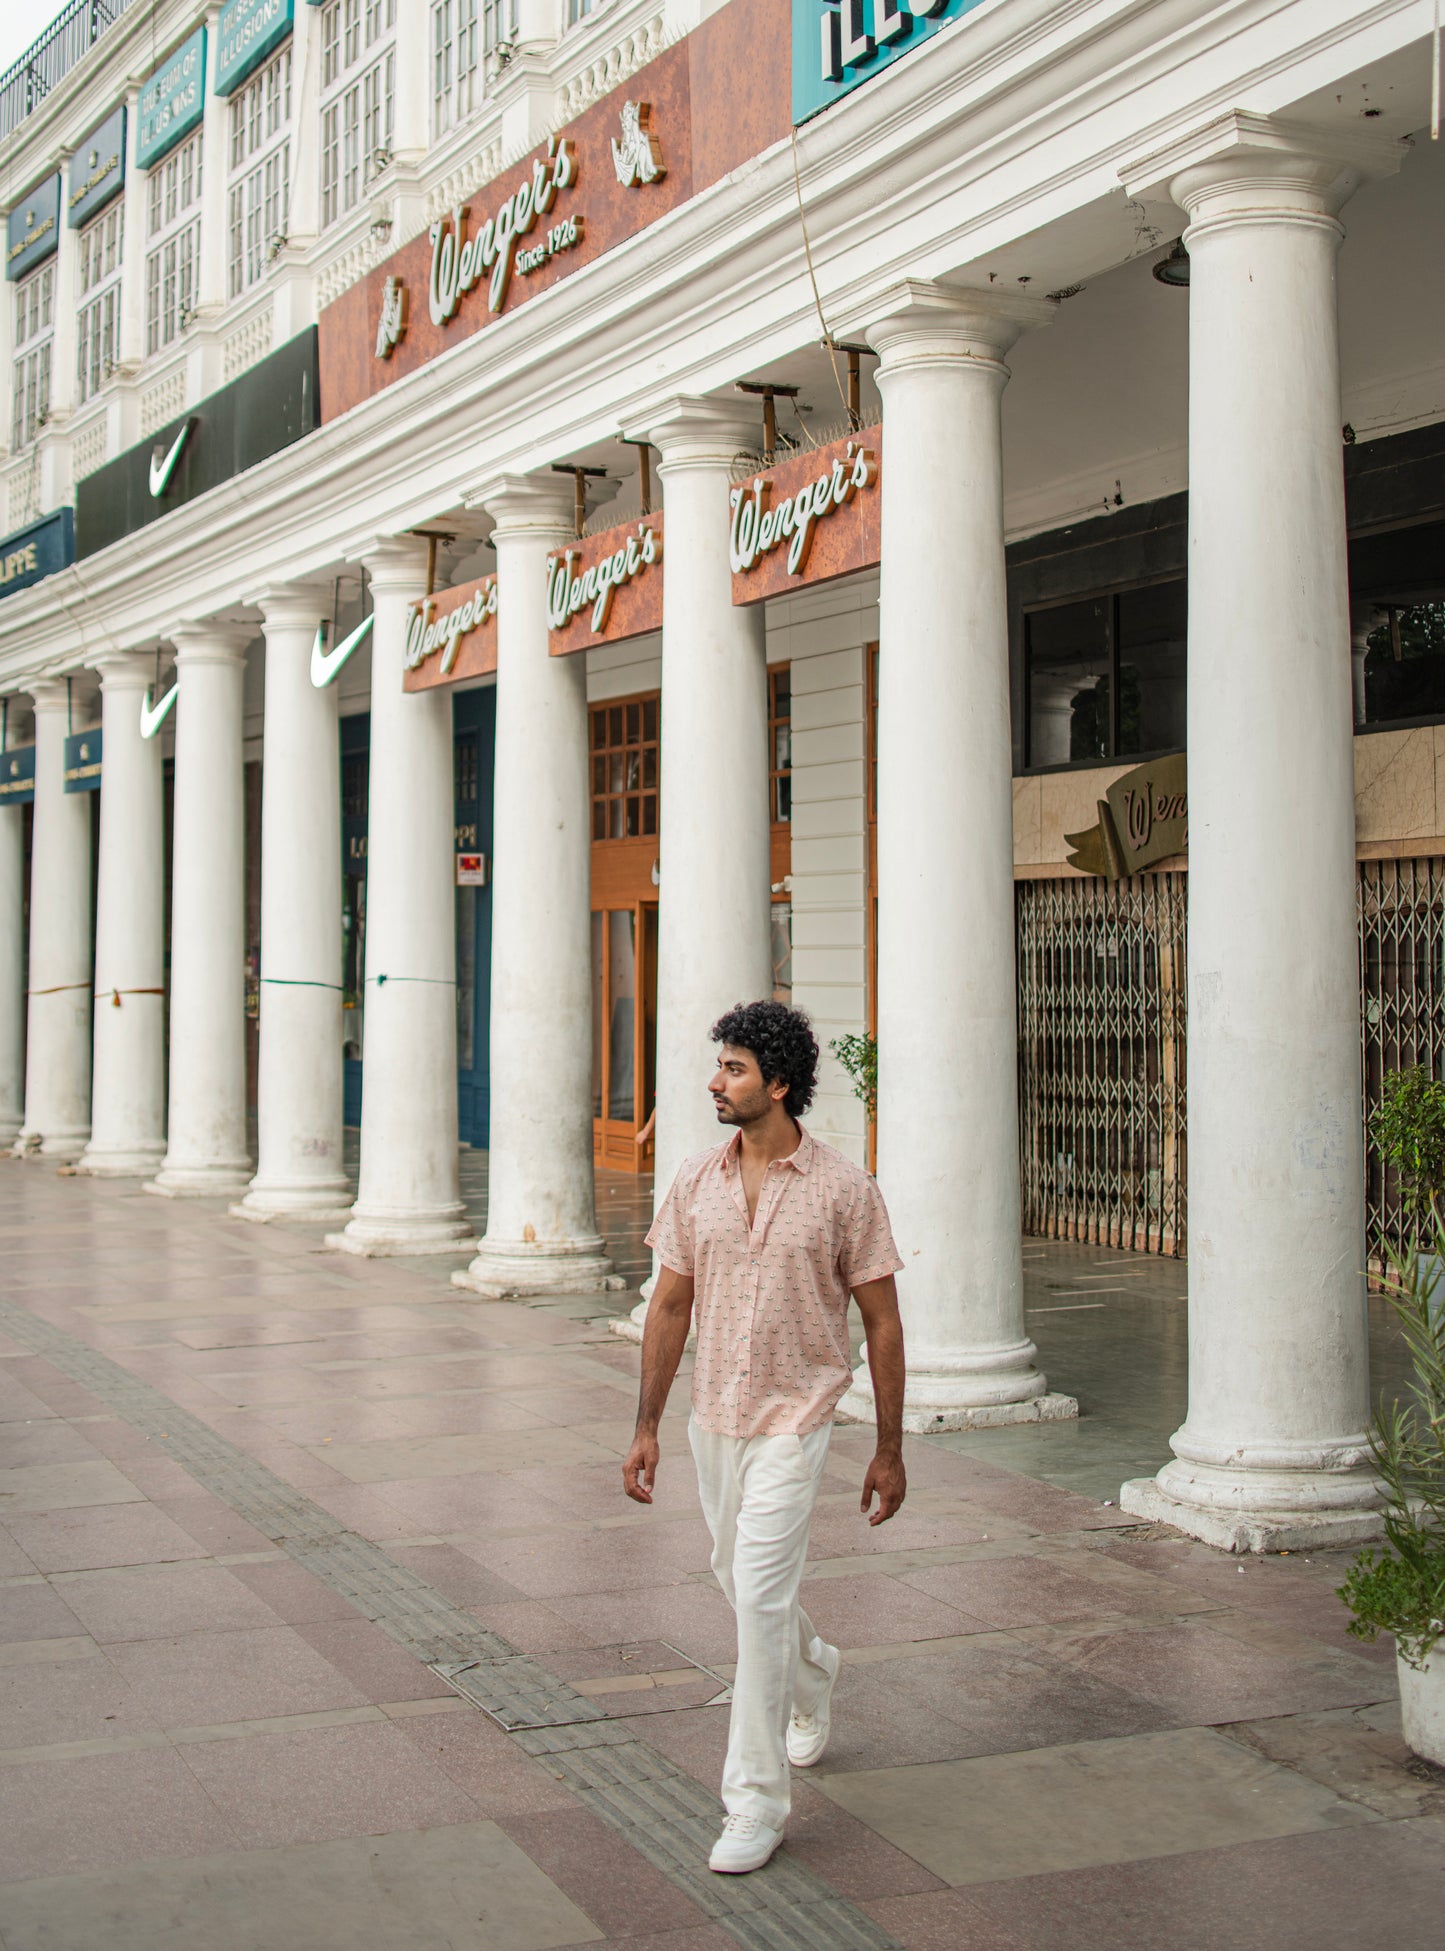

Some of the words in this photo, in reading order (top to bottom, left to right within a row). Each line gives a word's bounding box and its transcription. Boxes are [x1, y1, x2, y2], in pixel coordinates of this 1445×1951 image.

[219, 0, 280, 72] ILLUSIONS
[820, 0, 946, 81] ILL
[140, 80, 196, 149] ILLUSIONS
[142, 63, 181, 117] MUSEUM
[183, 47, 197, 77] OF
[429, 134, 574, 326] Wenger's
[515, 243, 545, 277] Since
[547, 214, 578, 255] 1926
[729, 441, 869, 576] Wenger's
[546, 522, 656, 633] Wenger's
[402, 578, 497, 674] Wenger's
[1123, 781, 1187, 851] Wen
